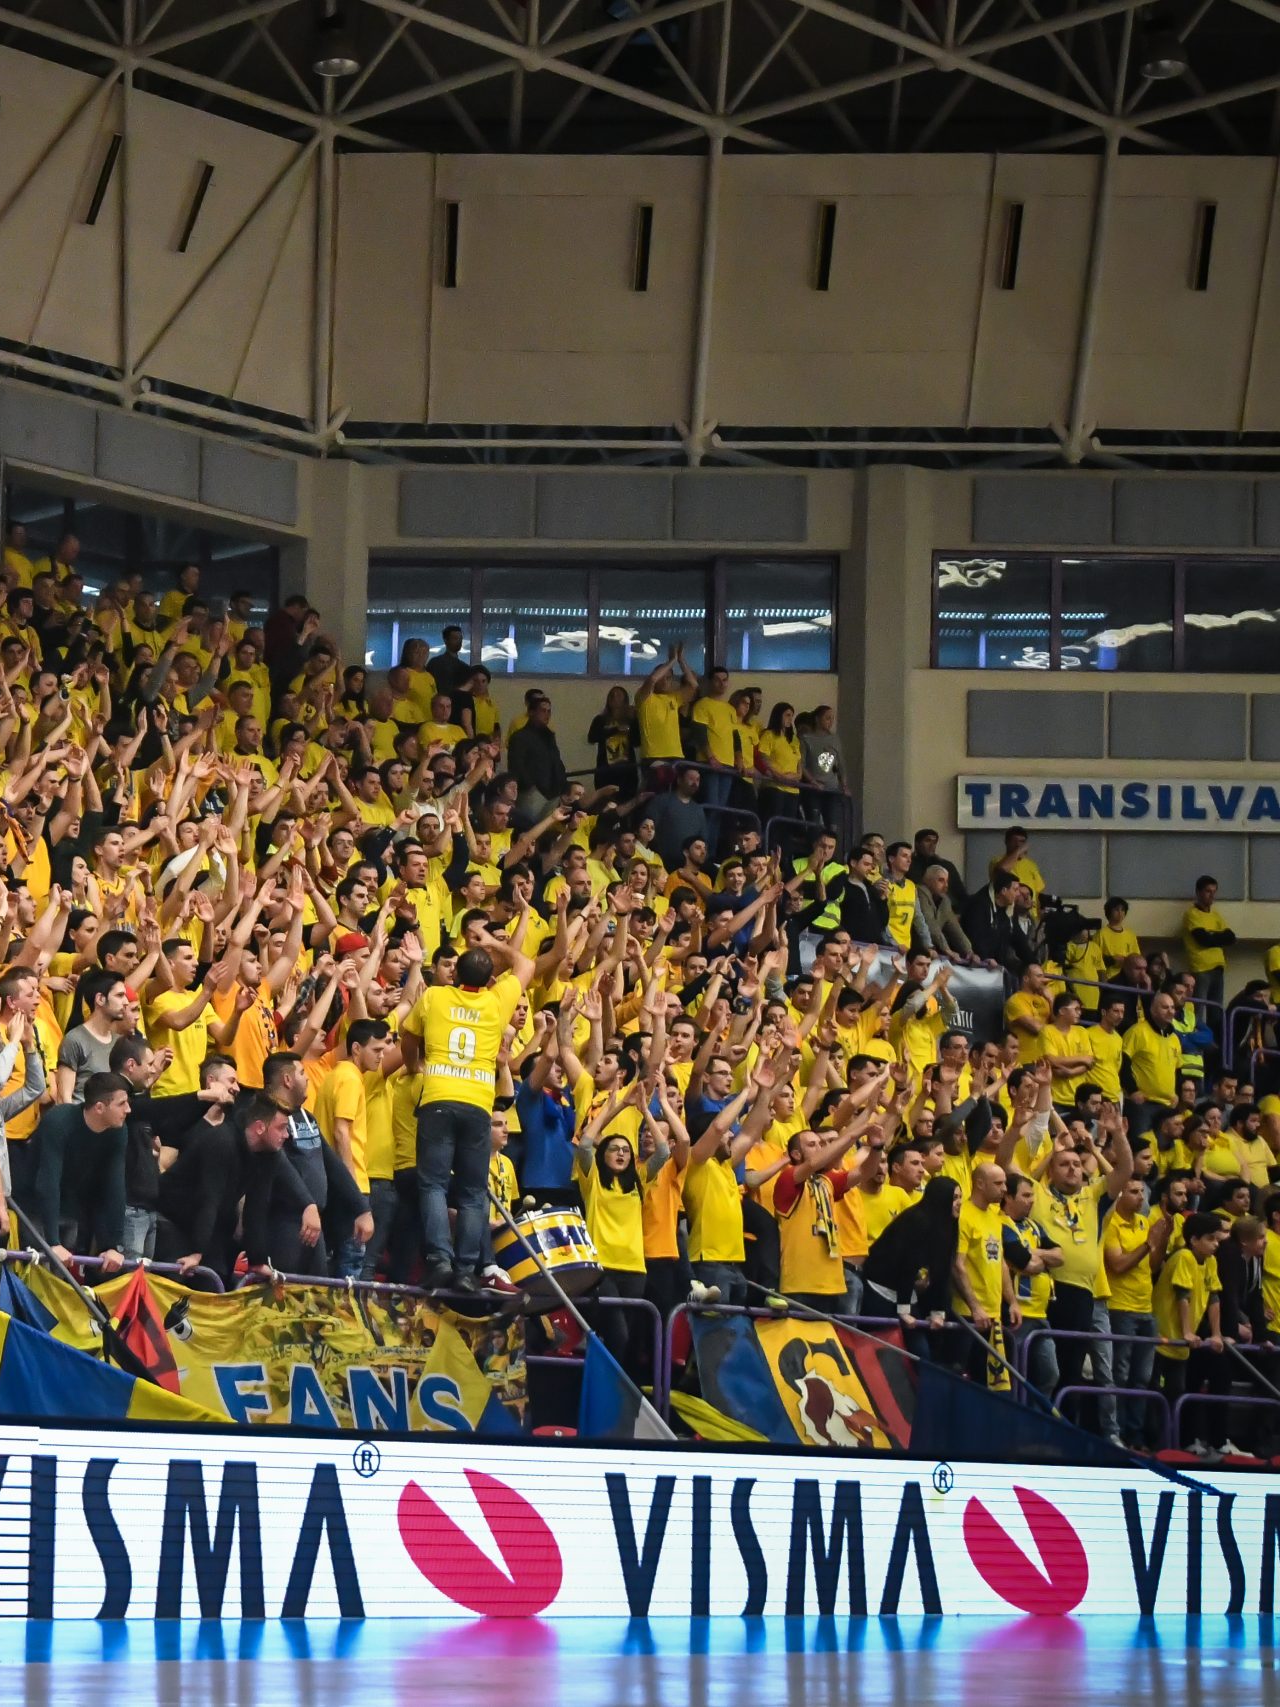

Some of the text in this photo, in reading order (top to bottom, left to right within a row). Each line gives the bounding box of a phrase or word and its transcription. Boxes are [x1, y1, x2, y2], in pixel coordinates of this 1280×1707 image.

[965, 783, 1280, 820] TRANSILVA
[448, 1026, 477, 1065] 9
[213, 1363, 475, 1431] FANS
[605, 1472, 943, 1616] VISMA
